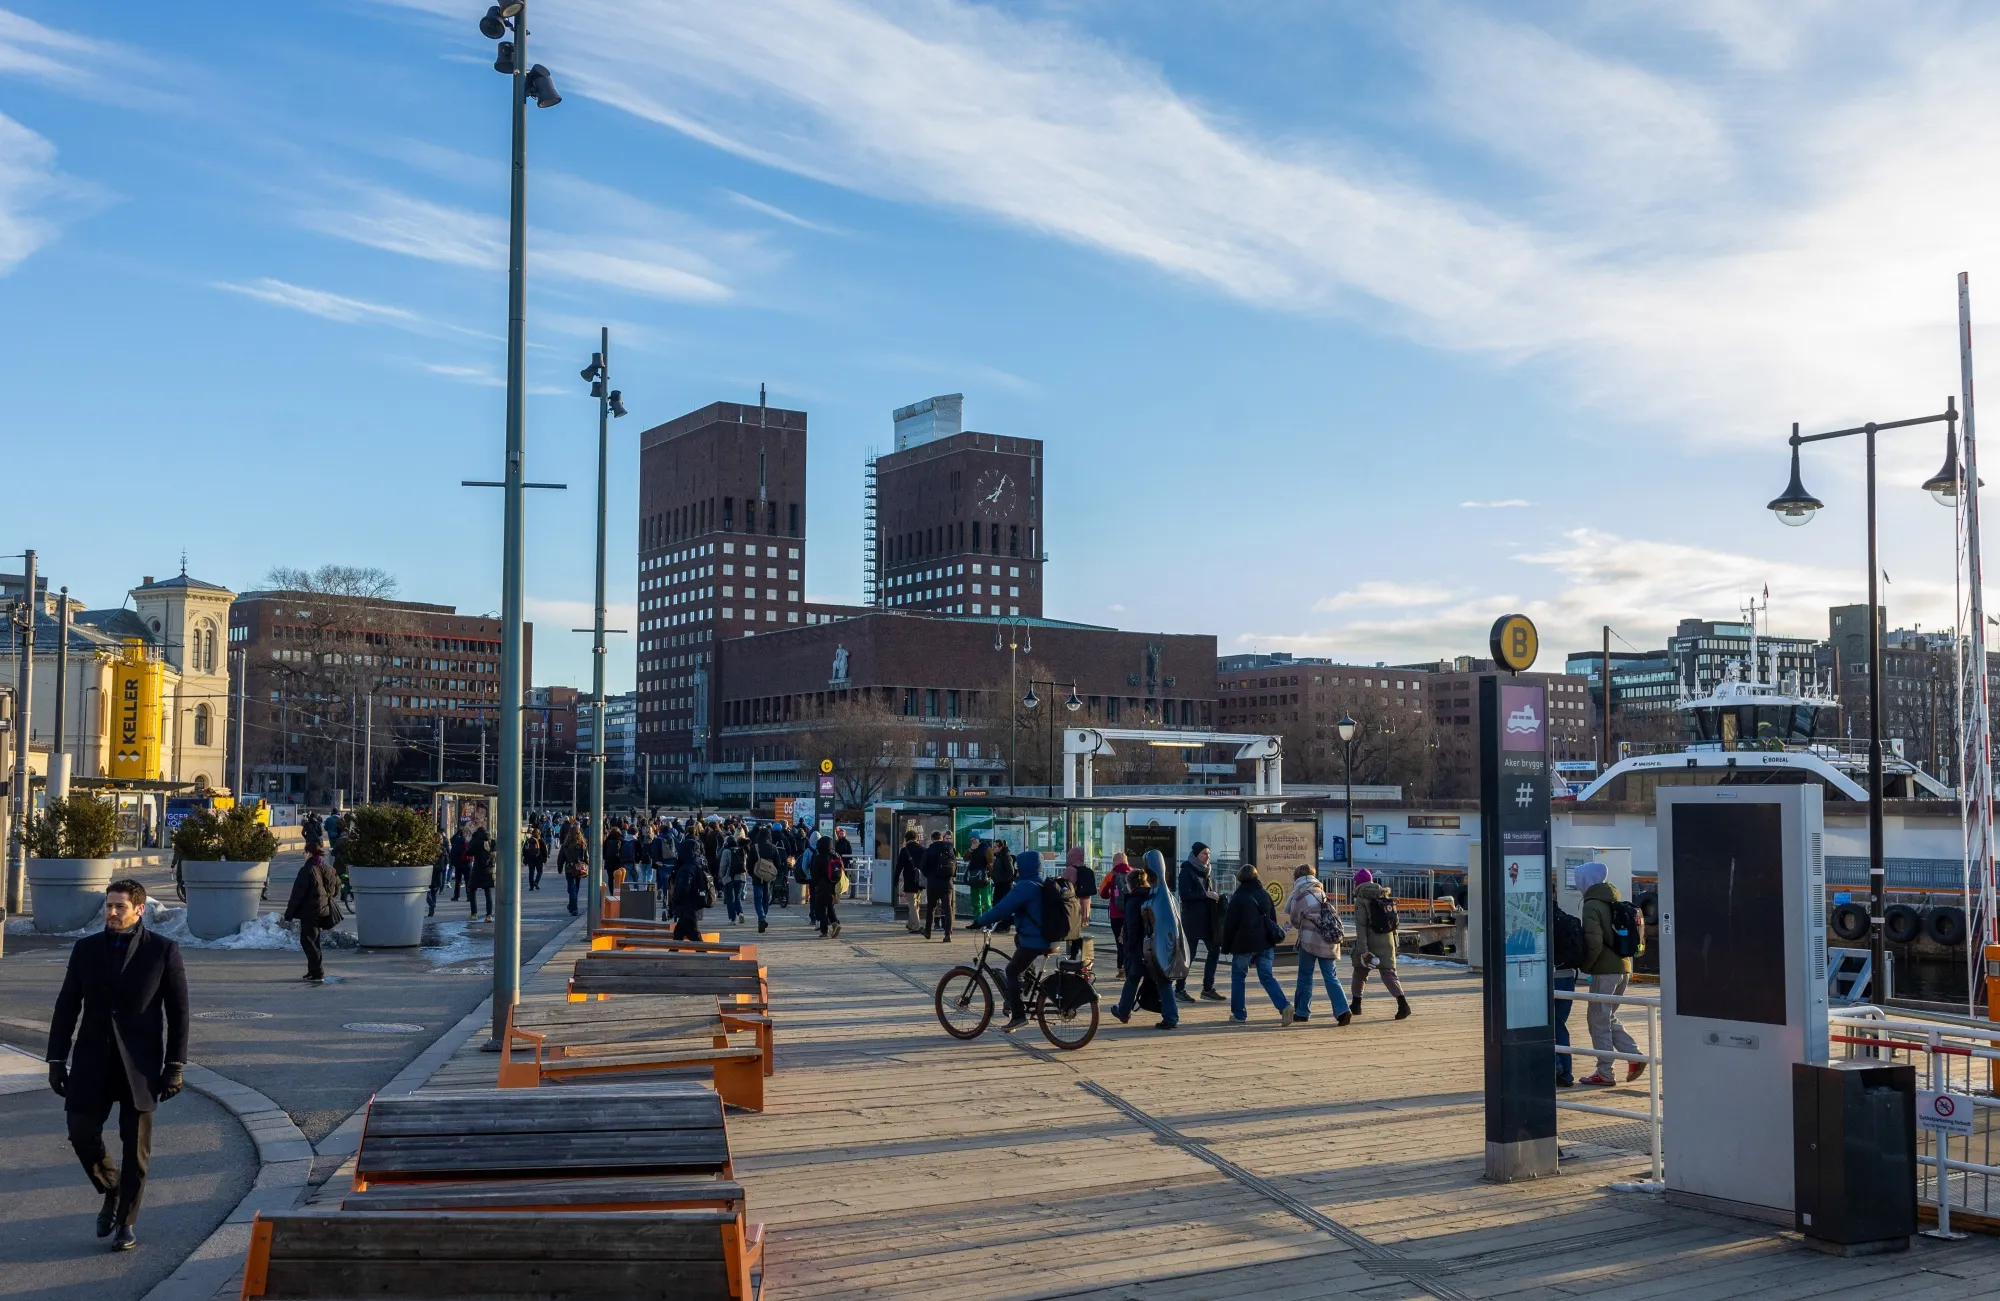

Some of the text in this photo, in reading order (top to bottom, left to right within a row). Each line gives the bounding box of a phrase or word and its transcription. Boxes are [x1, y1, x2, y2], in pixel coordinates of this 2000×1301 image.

[1512, 626, 1528, 658] B
[123, 679, 139, 744] KELLER
[823, 761, 830, 771] C
[1504, 758, 1544, 770] Aker brygge
[784, 801, 794, 814] 06
[1918, 1114, 1971, 1127] Sykkelparkering forbudt
